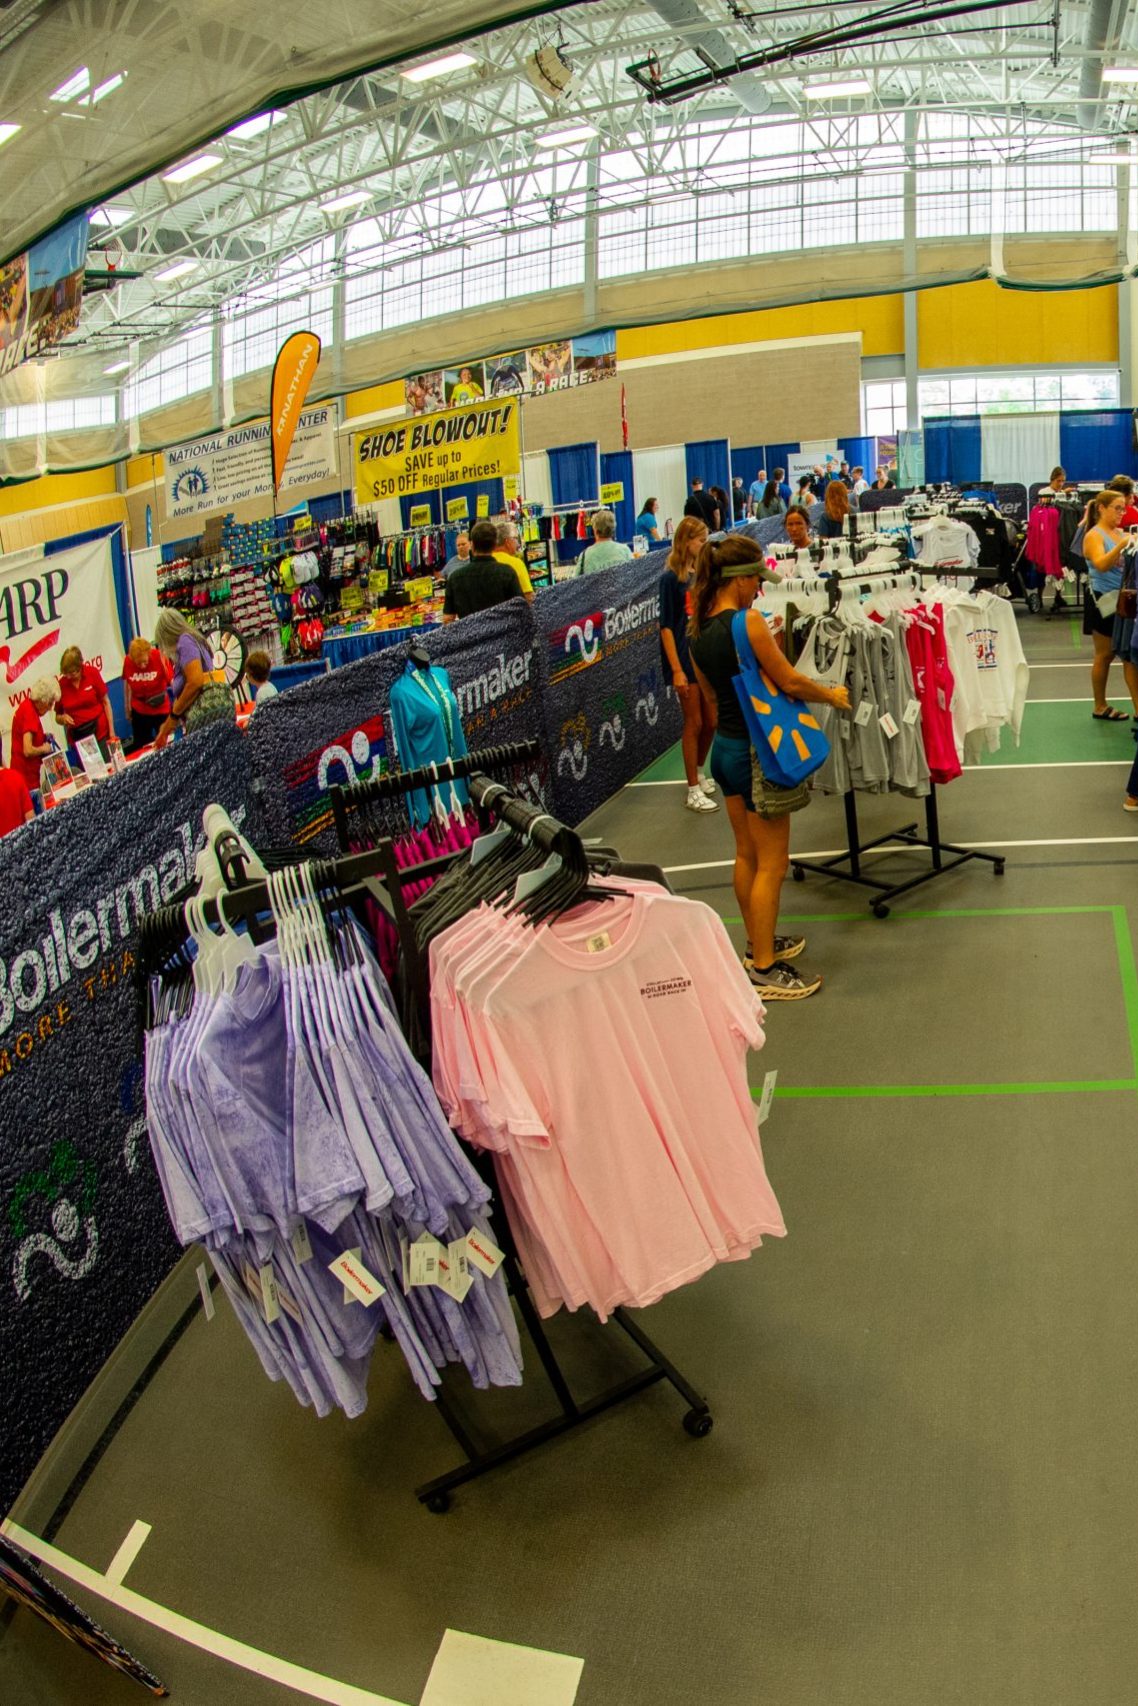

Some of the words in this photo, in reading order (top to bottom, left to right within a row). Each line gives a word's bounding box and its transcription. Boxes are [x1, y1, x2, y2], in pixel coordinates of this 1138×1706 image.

[169, 440, 222, 464] NATIONAL
[227, 425, 271, 447] RUNNIN
[359, 428, 406, 463] SHOE
[411, 404, 513, 450] BLOWOUT!
[373, 477, 395, 499] $50
[398, 472, 418, 492] OFF
[422, 467, 460, 488] Regular
[462, 459, 500, 480] Prices!
[405, 451, 433, 473] SAVE
[437, 453, 449, 468] up
[451, 450, 461, 464] to
[173, 506, 193, 518] More
[197, 497, 213, 510] Run
[217, 493, 229, 506] for
[232, 488, 250, 503] your
[288, 467, 330, 486] Everyday!
[640, 980, 692, 996] BOILERMAKER
[340, 1261, 373, 1295] Boilermaker
